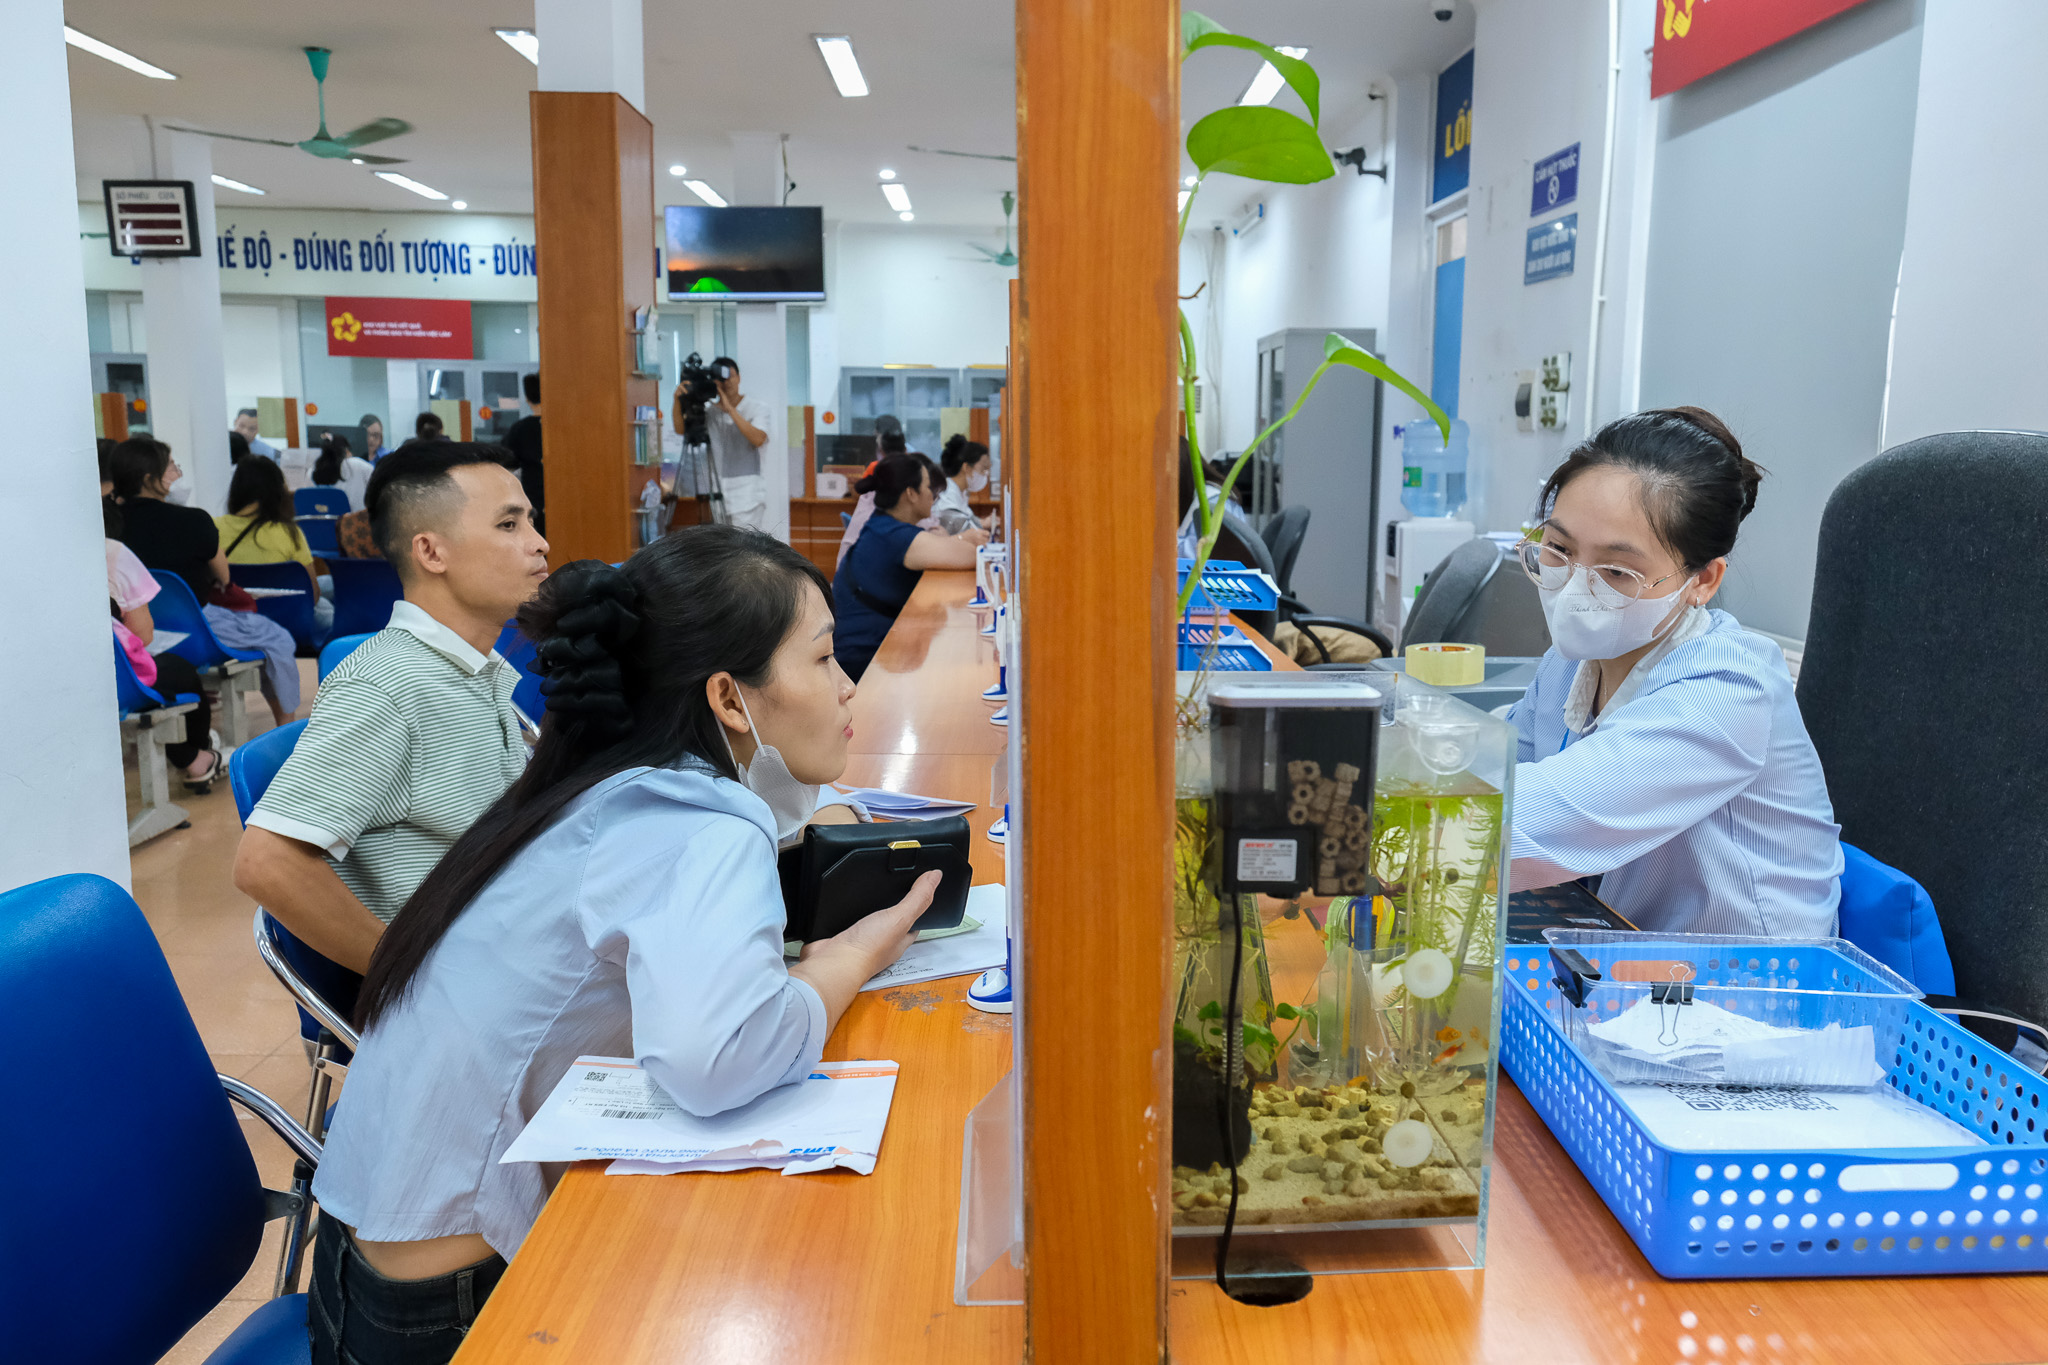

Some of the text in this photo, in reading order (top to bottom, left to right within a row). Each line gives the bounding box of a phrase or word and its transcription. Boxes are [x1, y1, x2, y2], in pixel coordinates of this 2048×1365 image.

[243, 230, 272, 277] ĐỘ
[294, 231, 352, 272] ĐÚNG
[359, 229, 394, 273] ĐỐI
[401, 238, 471, 282] TƯỢNG
